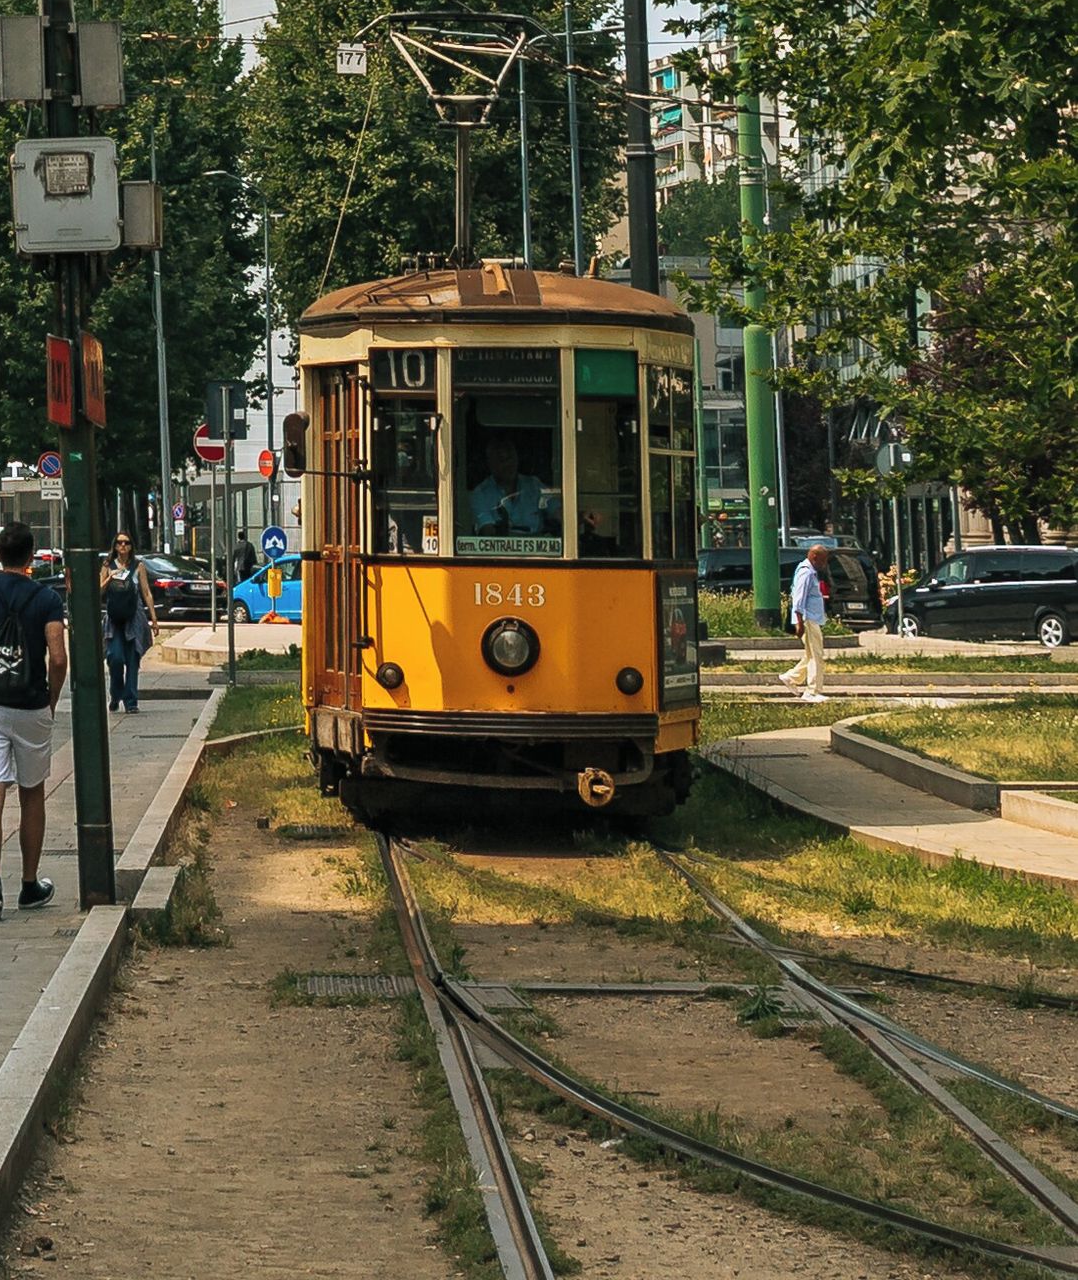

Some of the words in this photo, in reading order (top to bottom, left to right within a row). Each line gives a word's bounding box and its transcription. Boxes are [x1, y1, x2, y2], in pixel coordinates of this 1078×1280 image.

[338, 52, 365, 66] 177
[387, 349, 426, 388] 10
[426, 538, 438, 551] 10
[457, 540, 476, 551] term.
[478, 540, 523, 552] CENTRALE
[524, 540, 534, 552] FS
[536, 540, 548, 552] M2
[549, 540, 560, 552] M3
[474, 582, 545, 607] 1843
